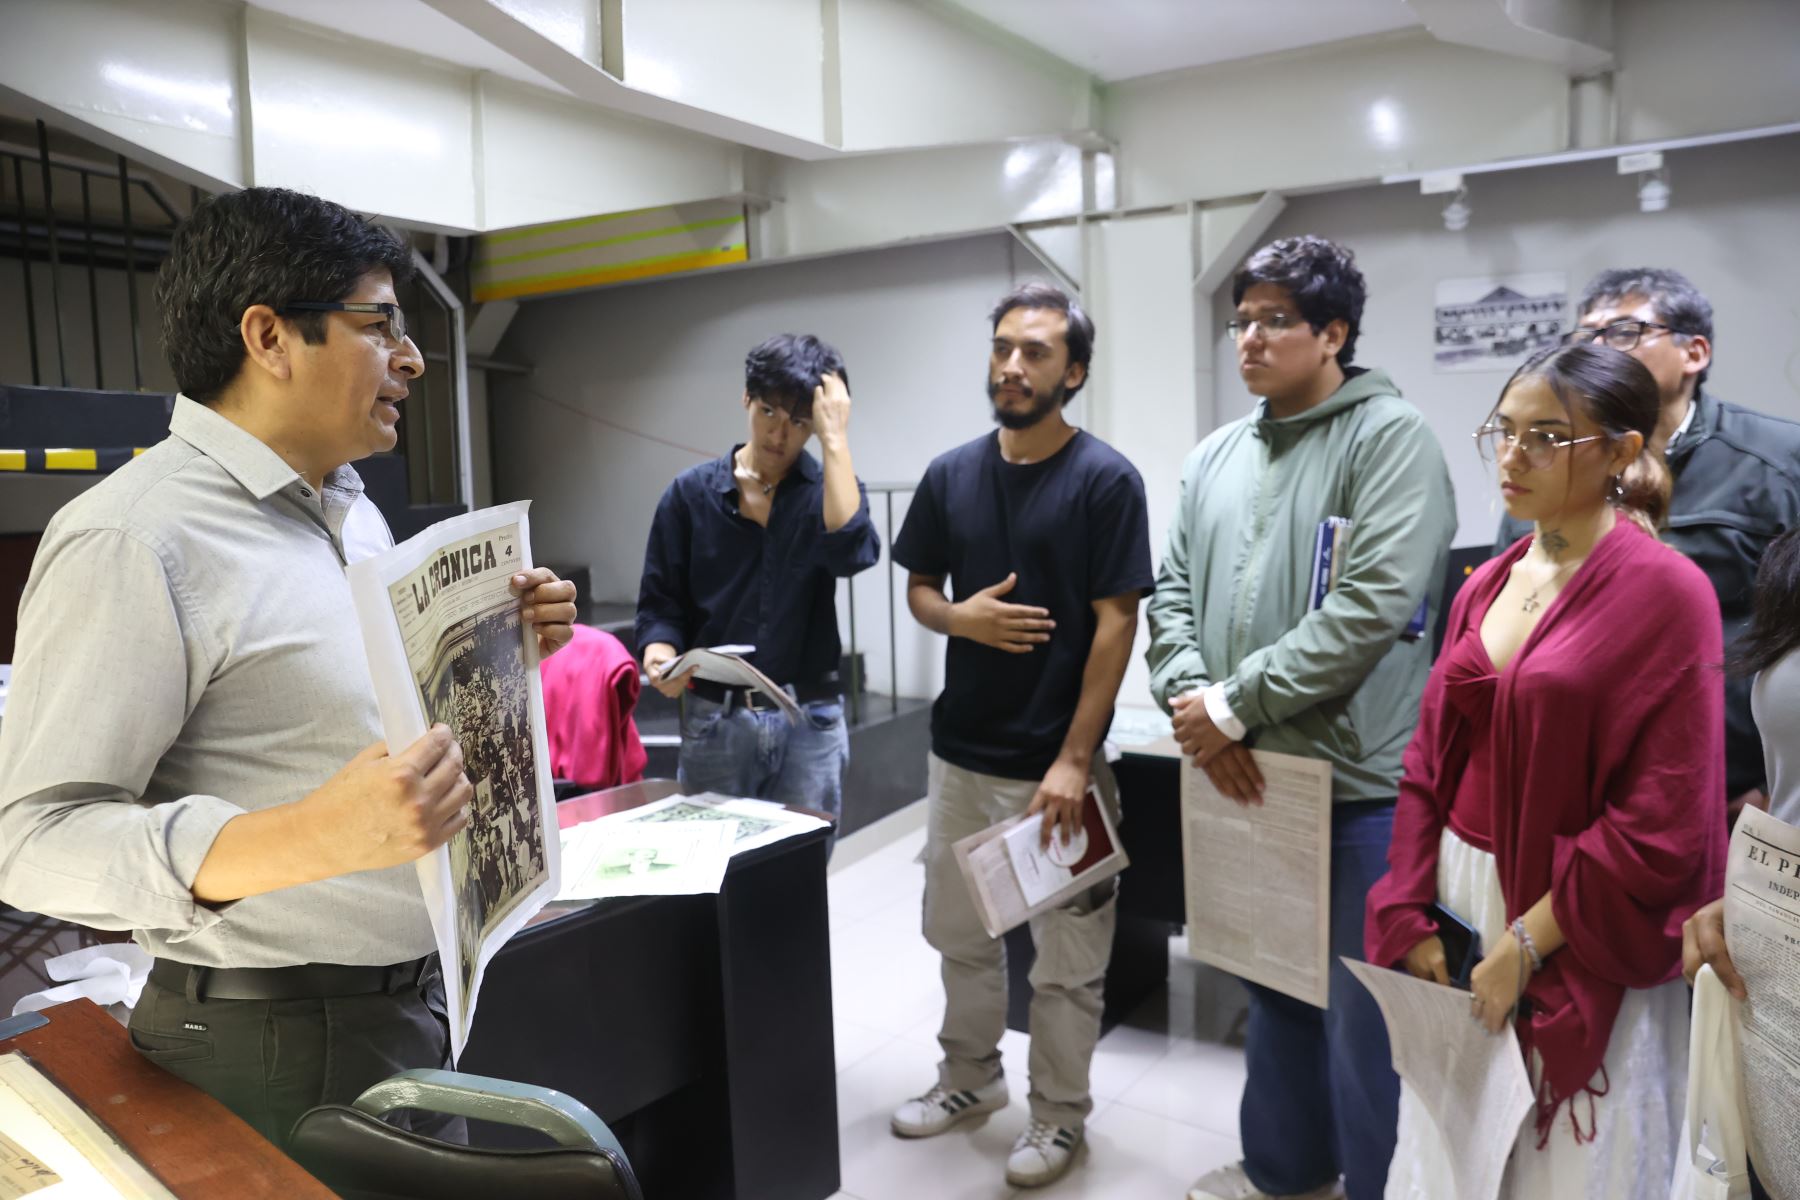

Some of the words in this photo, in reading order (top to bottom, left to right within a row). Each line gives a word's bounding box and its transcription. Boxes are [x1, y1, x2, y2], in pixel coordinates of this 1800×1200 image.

[505, 545, 512, 557] 4
[412, 575, 431, 615] LA
[1747, 845, 1769, 866] EL
